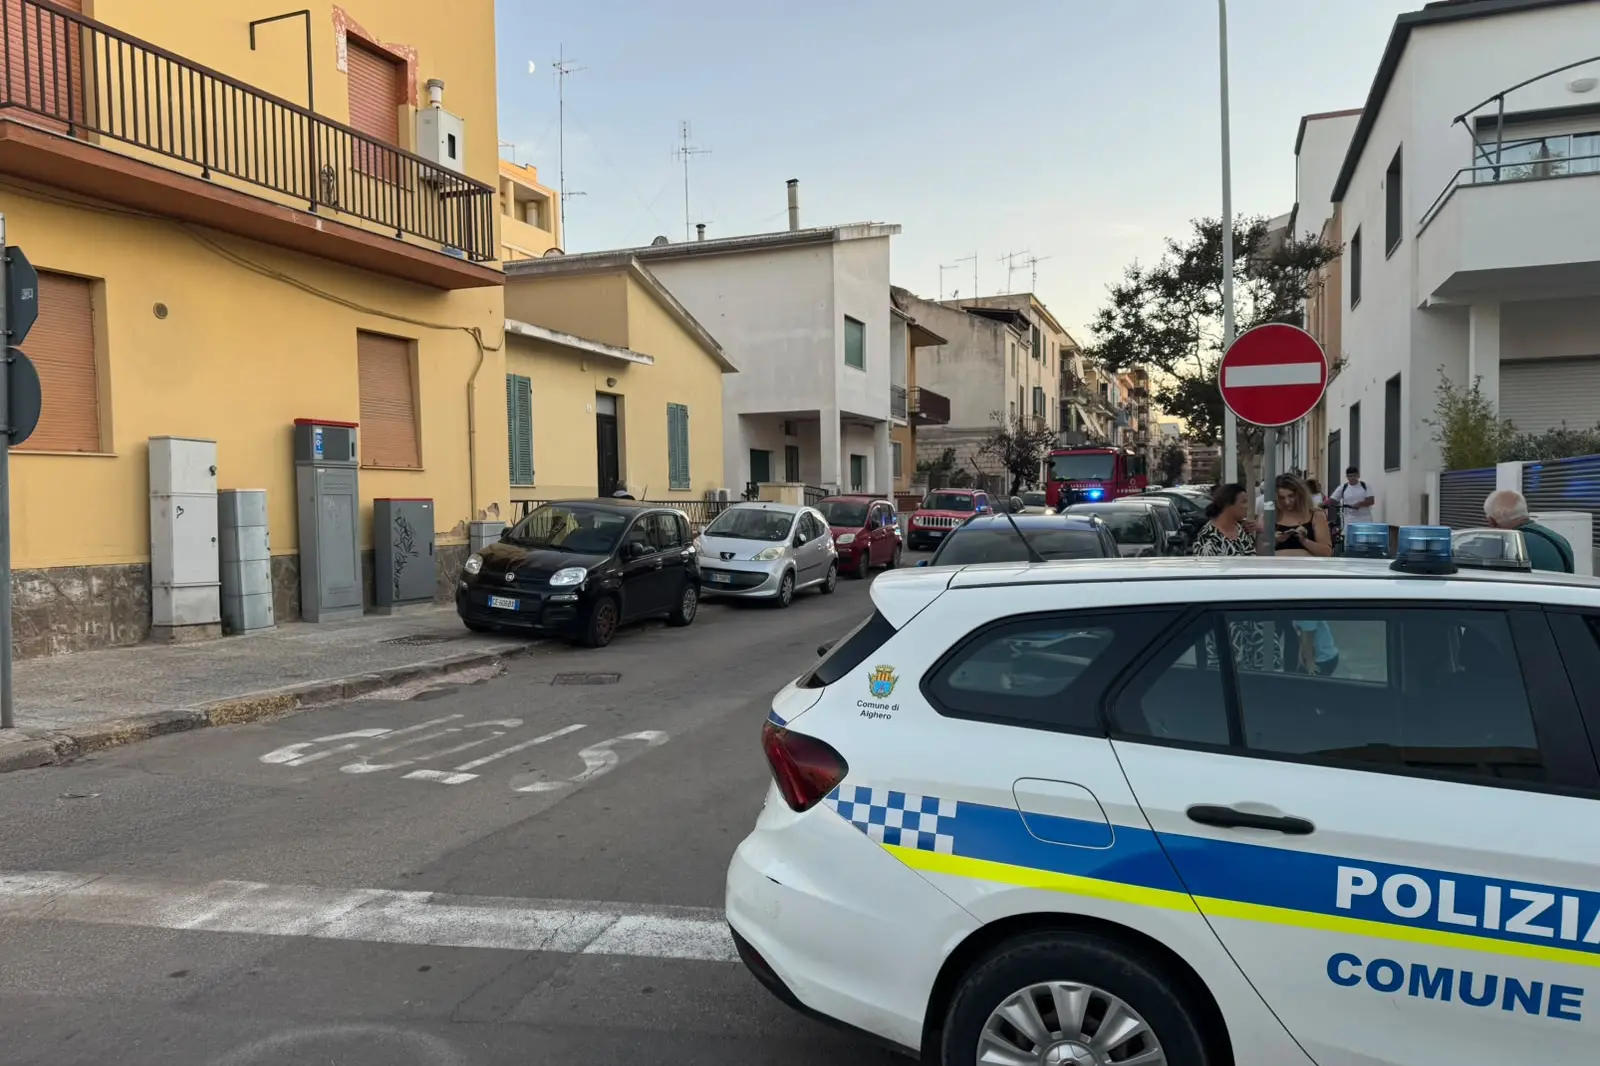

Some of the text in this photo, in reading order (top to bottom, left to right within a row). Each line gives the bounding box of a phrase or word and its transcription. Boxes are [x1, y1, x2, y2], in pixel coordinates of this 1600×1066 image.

[856, 700, 900, 711] Comune di
[860, 710, 892, 720] Alghero
[1326, 952, 1585, 1022] COMUNE
